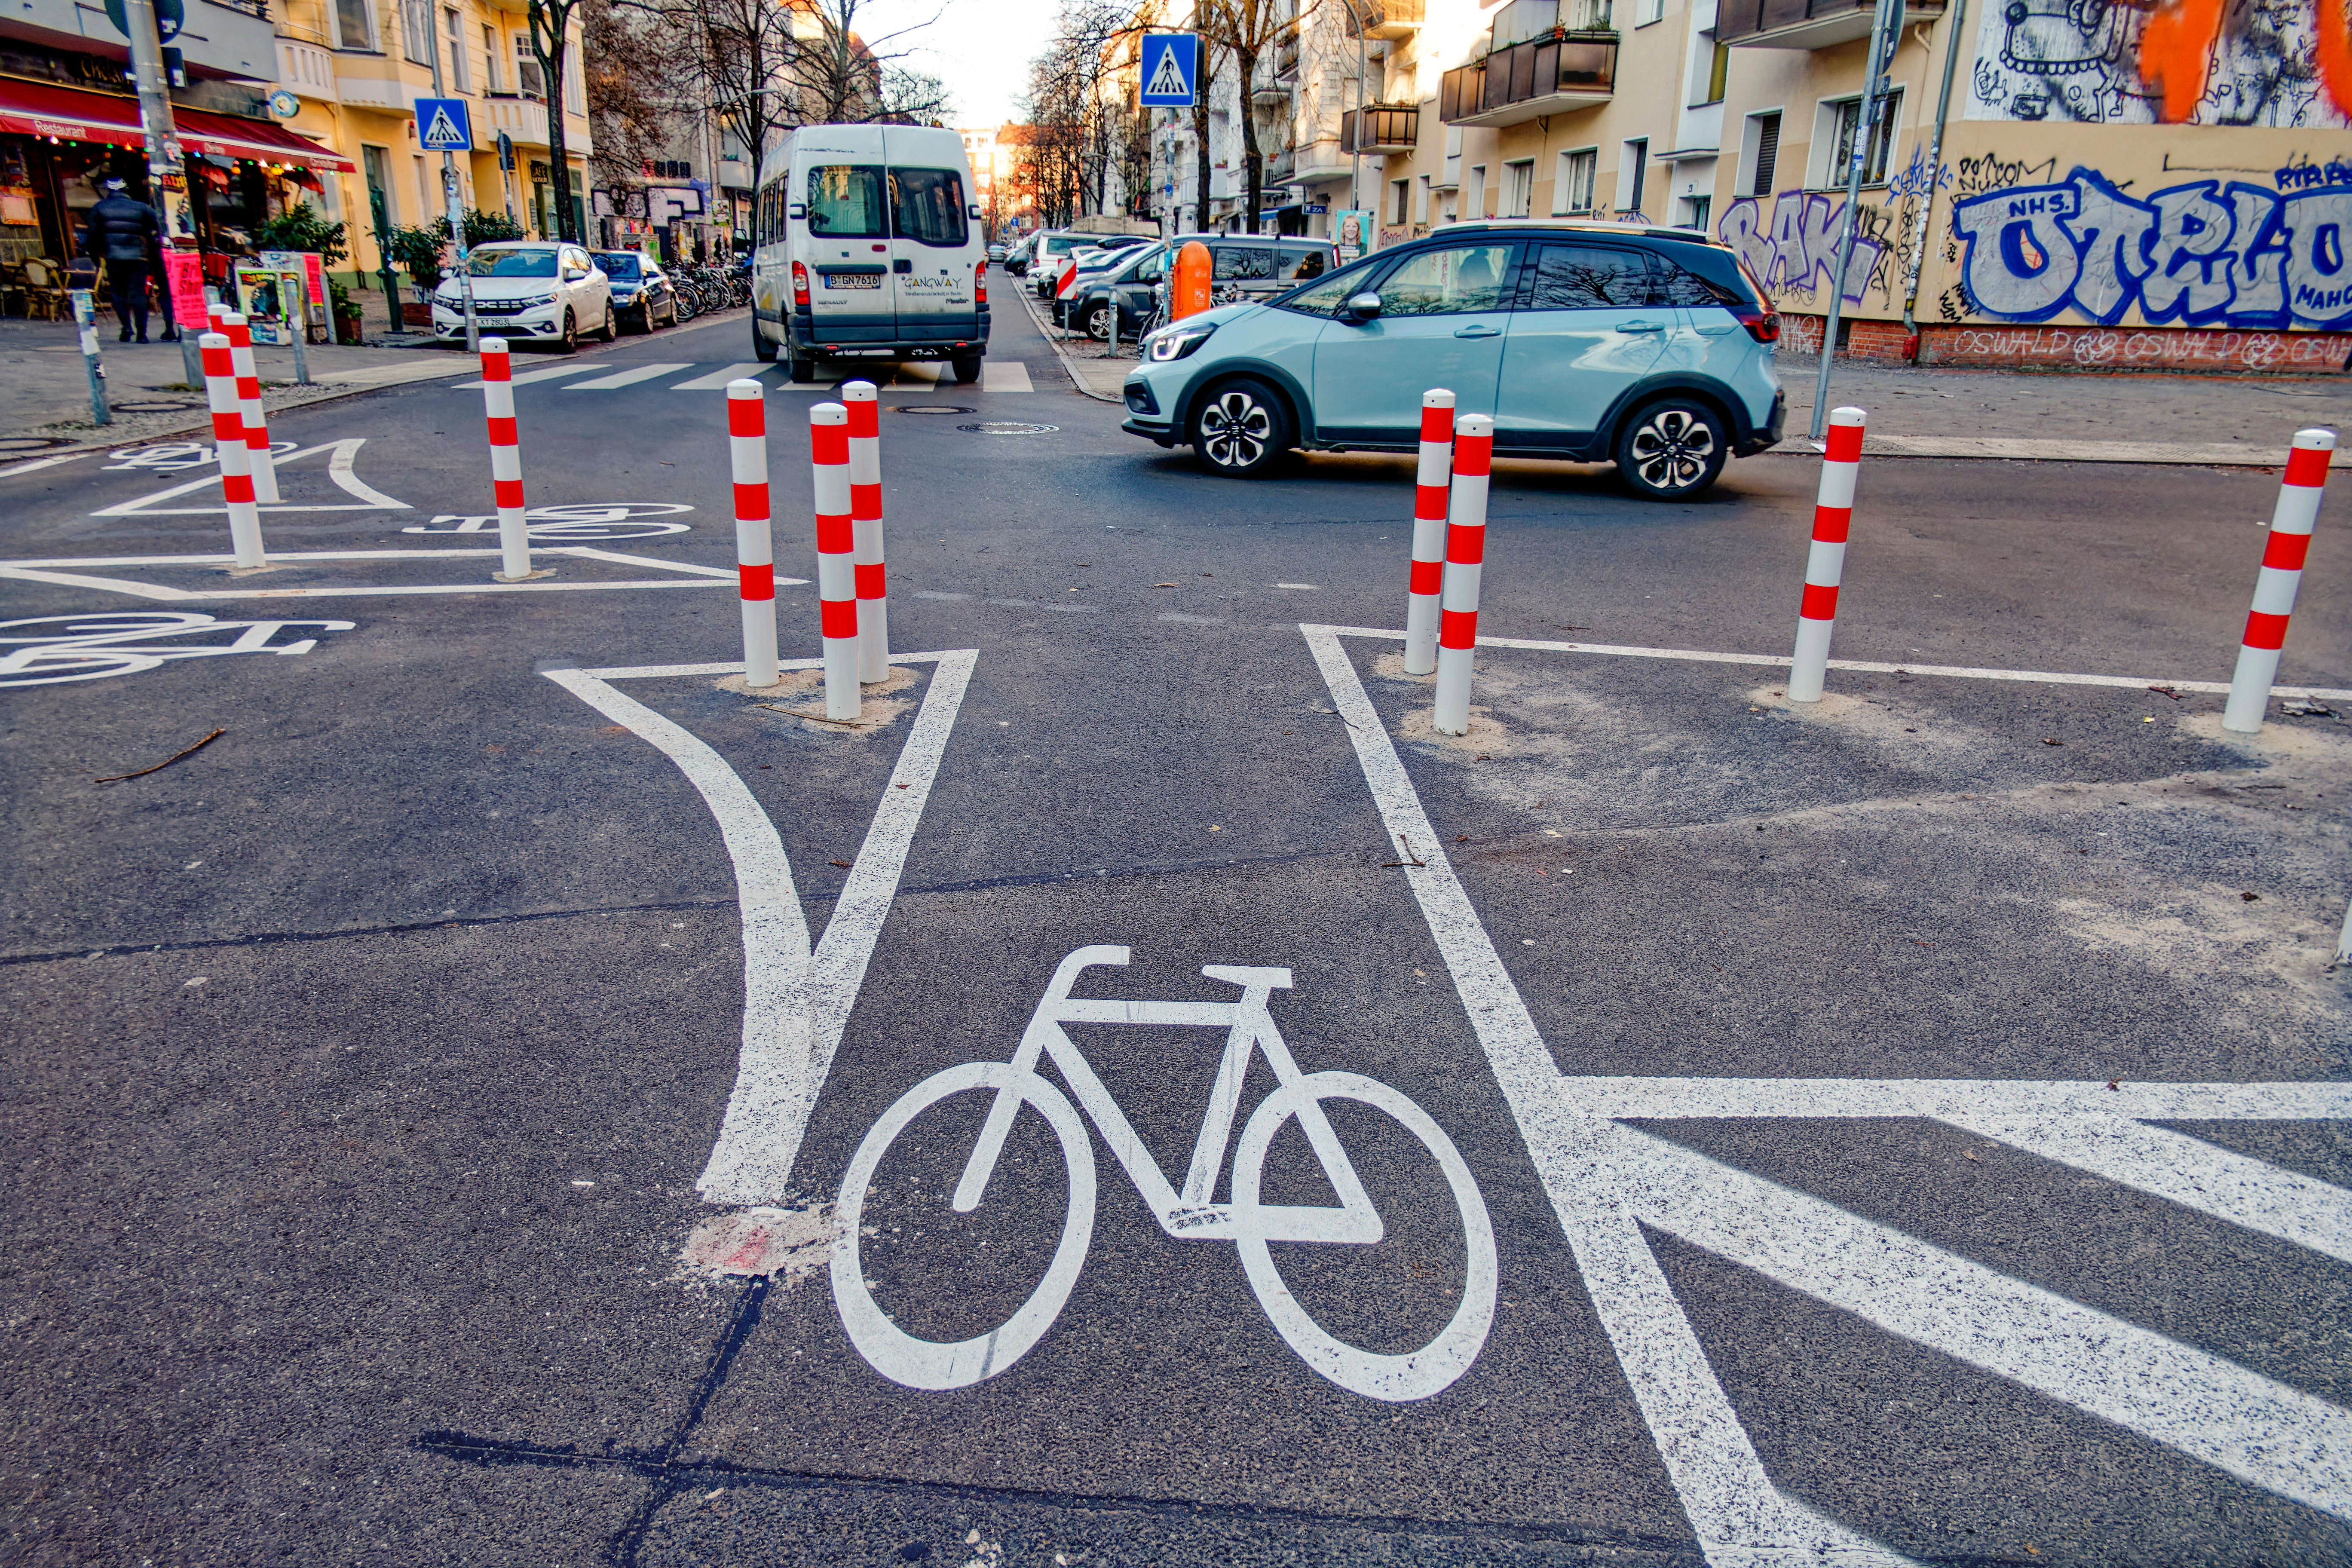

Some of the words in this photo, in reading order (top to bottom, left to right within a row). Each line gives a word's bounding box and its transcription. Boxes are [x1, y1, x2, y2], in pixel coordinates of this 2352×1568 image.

[34, 120, 87, 138] Restaurant
[2009, 193, 2070, 217] NHS.
[831, 276, 837, 285] B
[904, 277, 962, 290] GANGWAY
[1954, 328, 2071, 355] OSWALD
[2125, 332, 2241, 360] OSWALD
